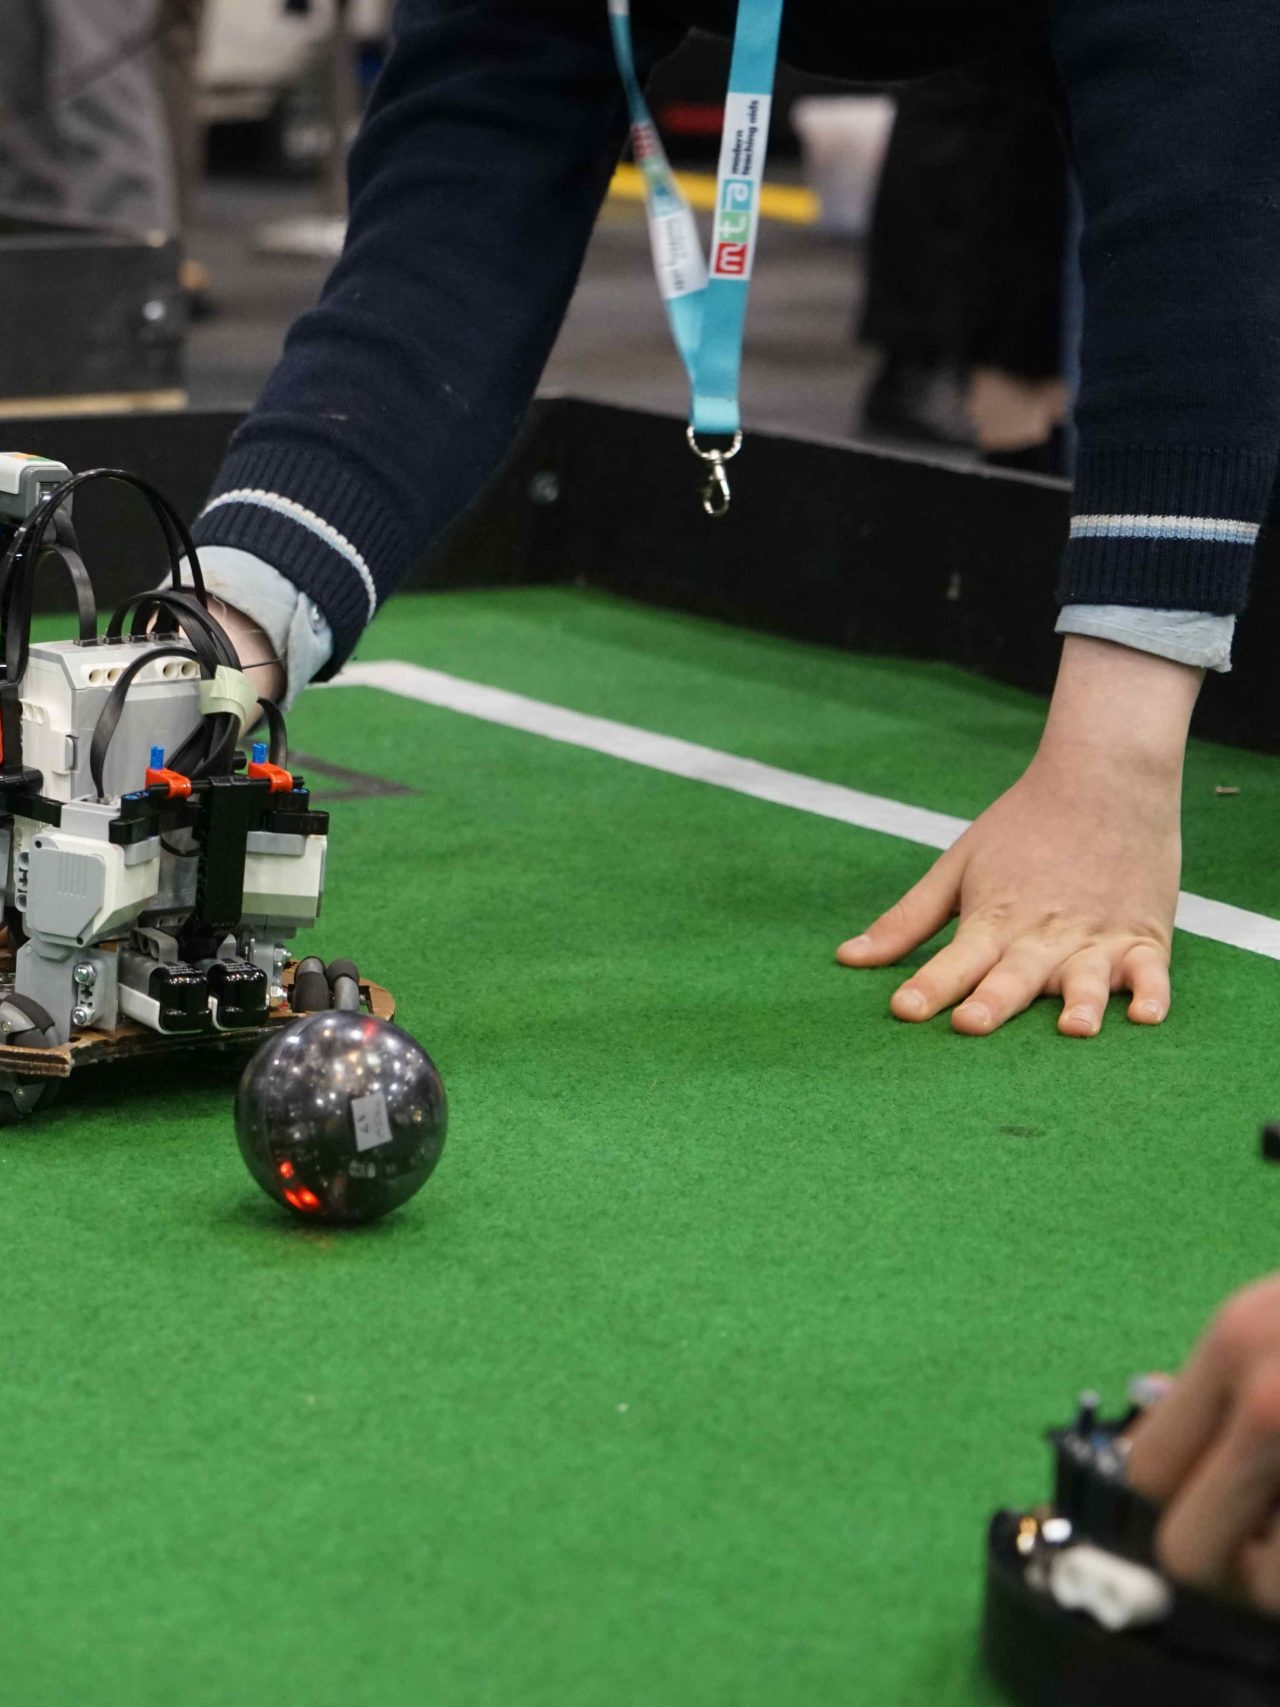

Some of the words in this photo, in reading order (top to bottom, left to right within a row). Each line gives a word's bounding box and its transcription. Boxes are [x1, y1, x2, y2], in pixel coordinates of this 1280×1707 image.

[748, 100, 759, 123] aids
[732, 130, 743, 174] modern
[741, 126, 758, 175] teaching
[716, 180, 753, 273] mta
